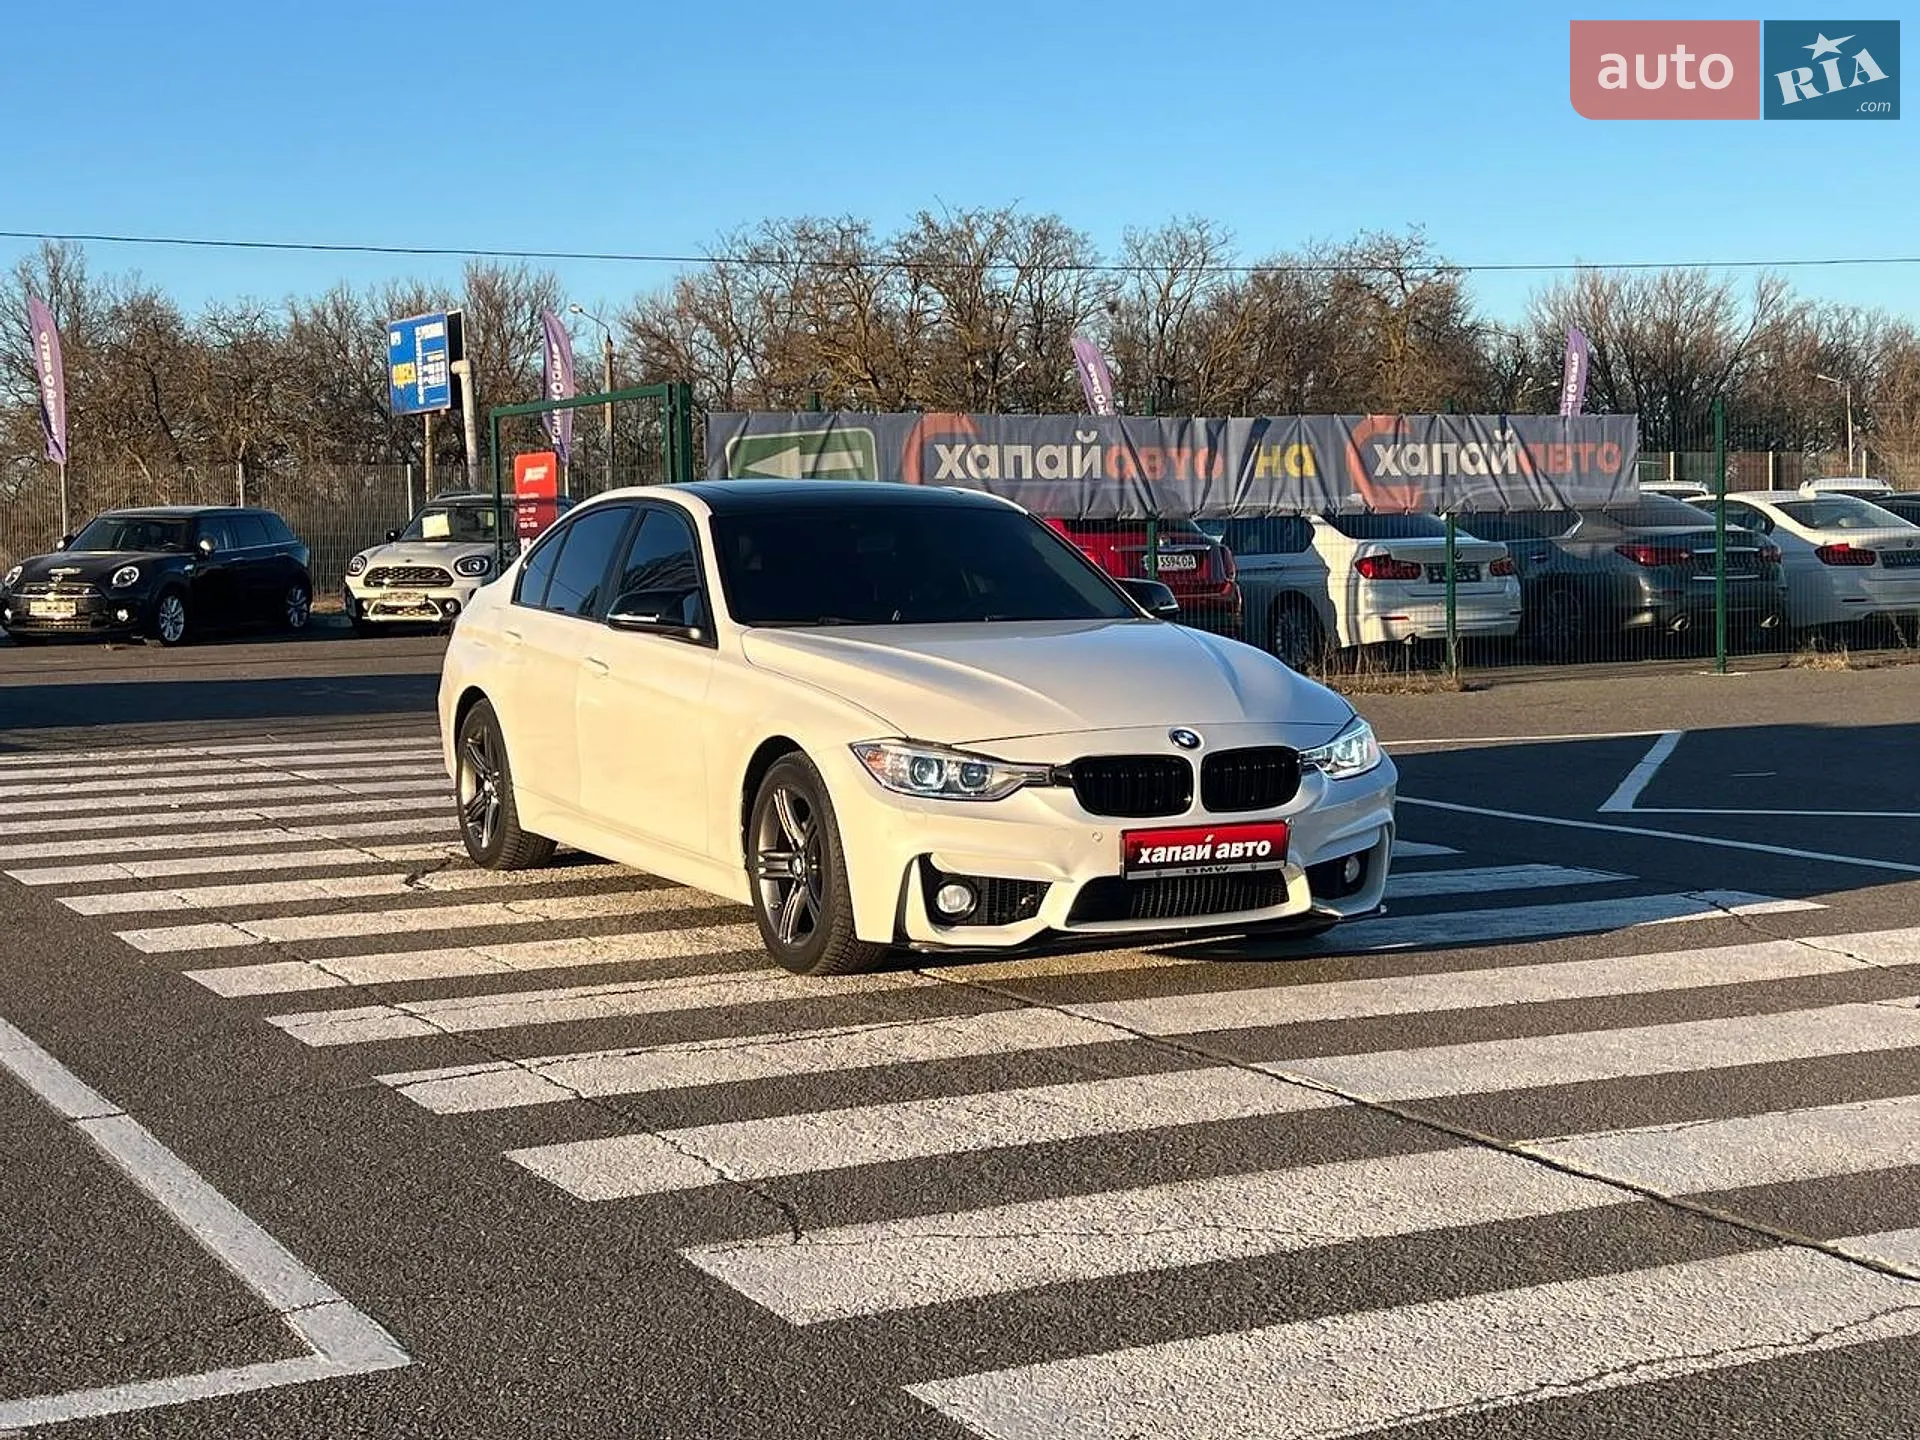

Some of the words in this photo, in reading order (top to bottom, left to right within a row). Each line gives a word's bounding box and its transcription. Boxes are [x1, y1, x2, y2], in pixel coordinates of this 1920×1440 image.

[1254, 443, 1317, 479] на
[1138, 834, 1214, 864] хапай
[1215, 840, 1271, 859] авто
